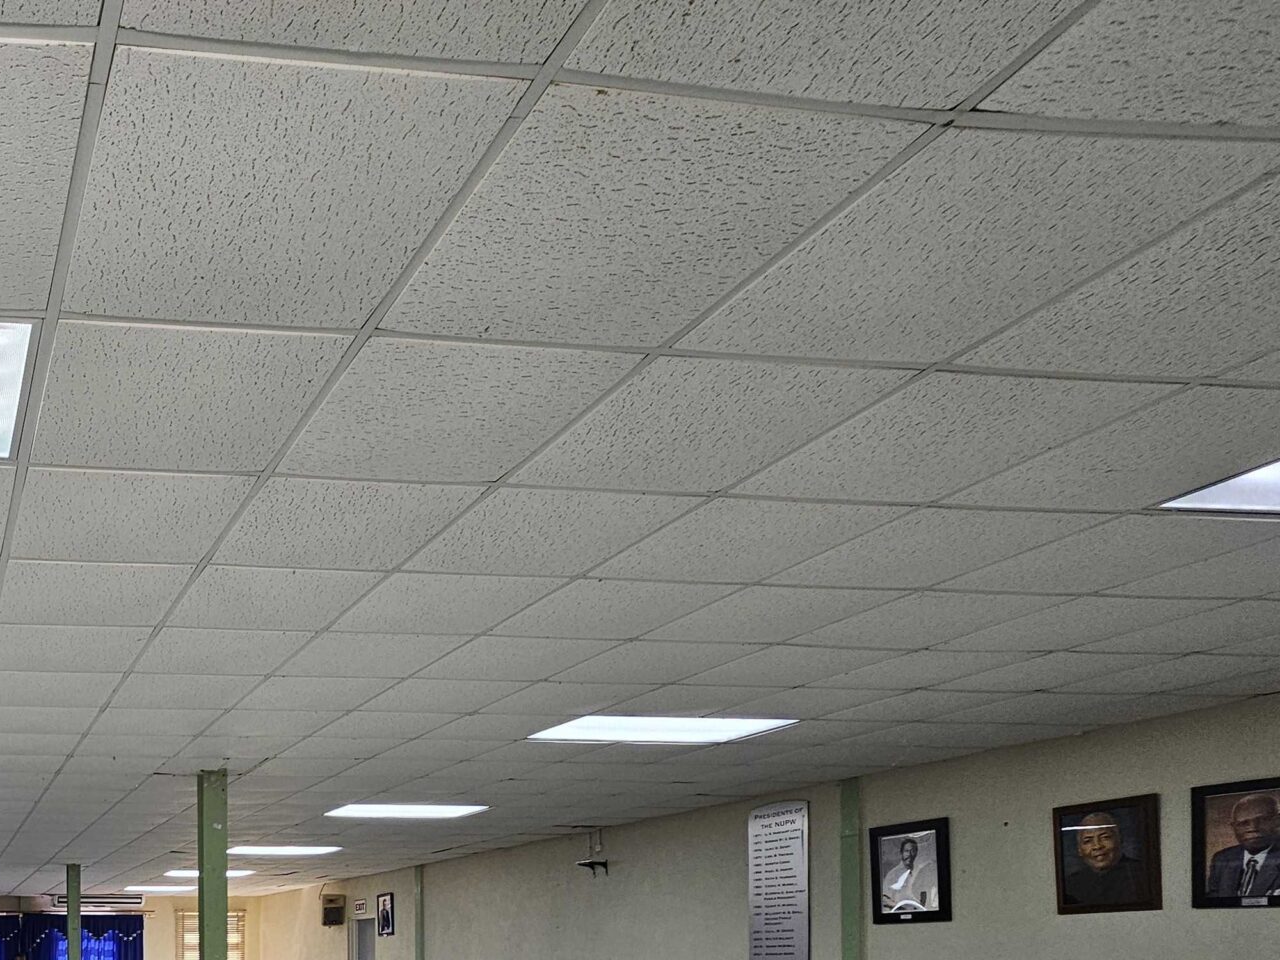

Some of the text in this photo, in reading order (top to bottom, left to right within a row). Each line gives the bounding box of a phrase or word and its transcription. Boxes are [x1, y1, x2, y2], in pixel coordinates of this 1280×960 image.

[754, 808, 793, 820] PRESIDENTS
[774, 818, 797, 828] NUPW
[355, 902, 365, 911] EXIT
